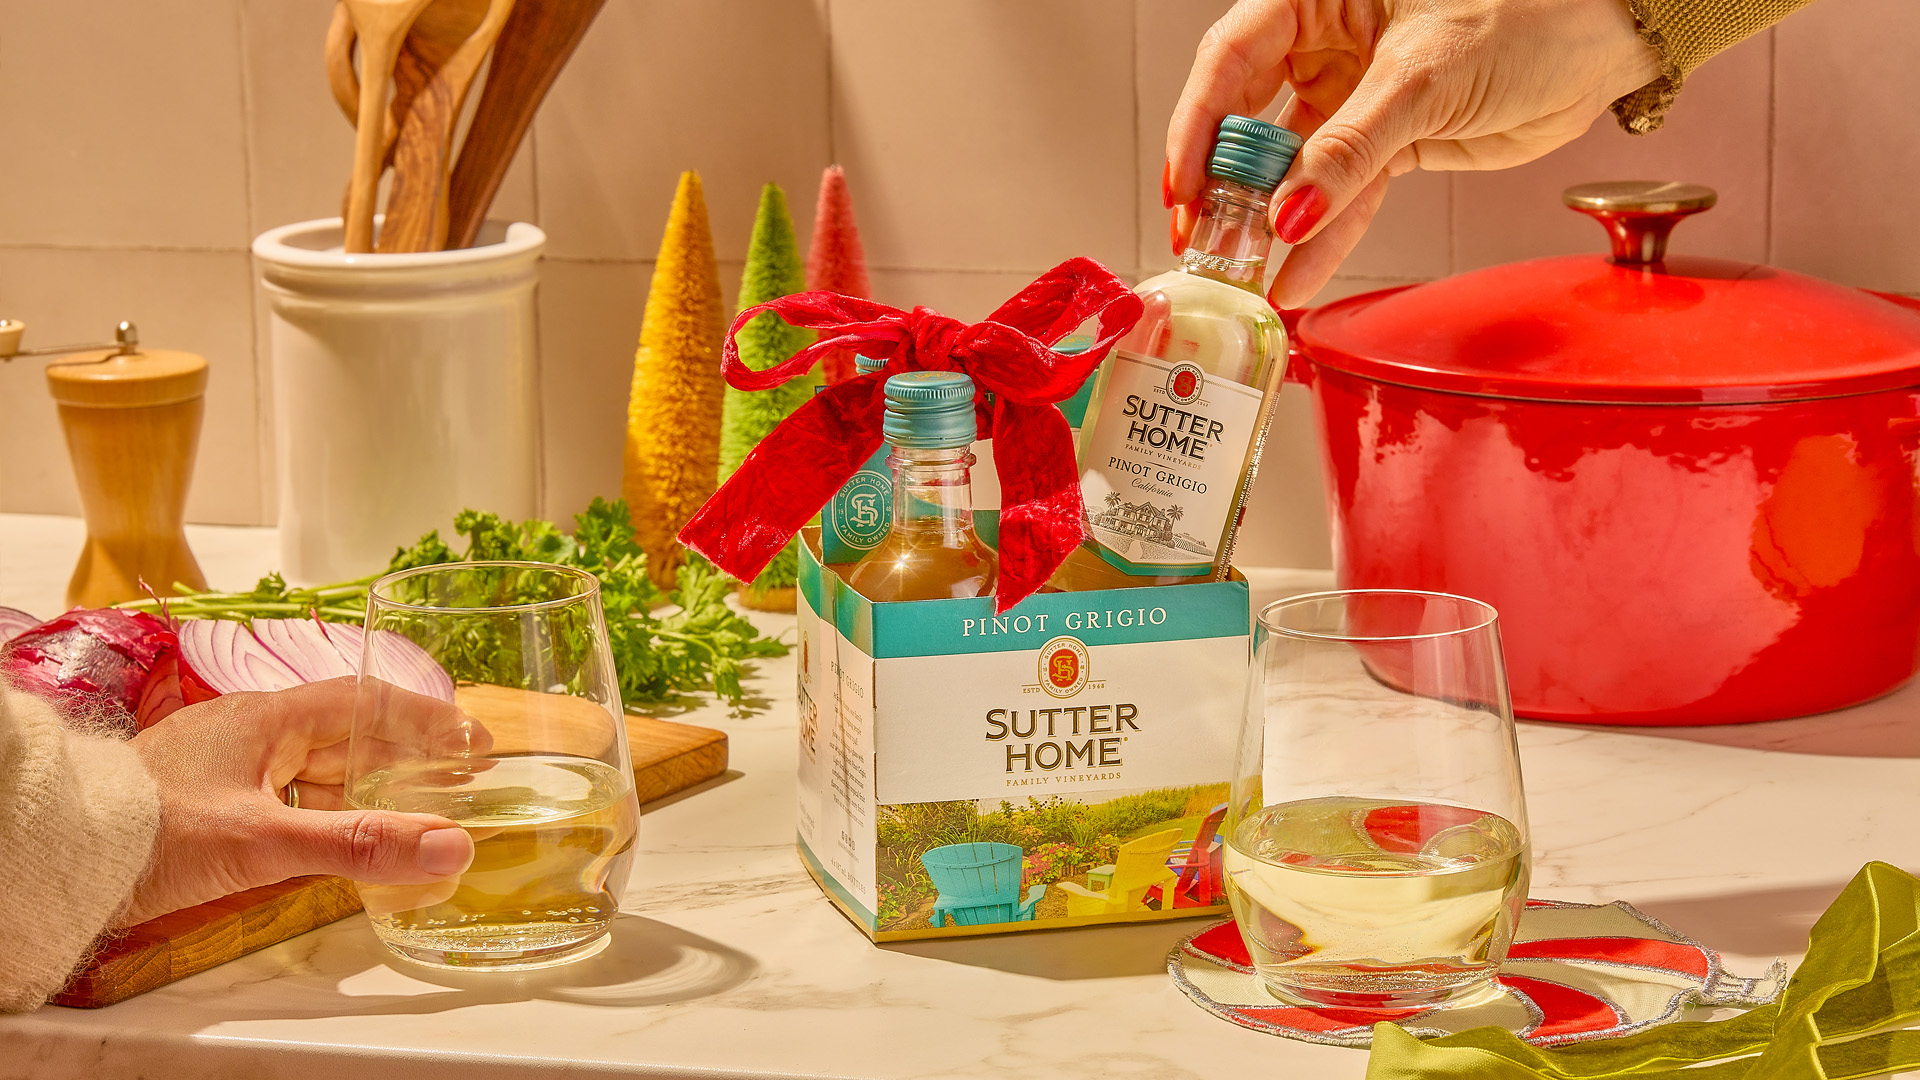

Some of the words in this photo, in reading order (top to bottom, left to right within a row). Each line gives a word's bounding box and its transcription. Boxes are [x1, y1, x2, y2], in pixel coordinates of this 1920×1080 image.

[1153, 387, 1166, 395] ESTD
[1122, 394, 1224, 444] SUTTER
[1127, 420, 1208, 462] HOME
[1125, 443, 1154, 457] FAMILY
[1157, 452, 1202, 470] VINEYARDS
[839, 476, 866, 498] SUTTER
[870, 477, 890, 496] HOME
[1108, 456, 1152, 478] PINOT
[1155, 470, 1208, 495] GRIGIO
[1131, 478, 1174, 498] California
[840, 524, 863, 543] FAMILY
[867, 522, 890, 543] OWNED
[962, 614, 1049, 637] PINOT
[1065, 607, 1168, 630] GRIGIO
[1044, 643, 1066, 659] SUTTER
[1068, 644, 1084, 658] HOME
[846, 675, 864, 699] GRIGIO
[1045, 679, 1062, 694] FAMILY
[1064, 677, 1083, 694] OWNED
[985, 703, 1142, 742] SUTTER
[1005, 737, 1123, 774] HOME
[1006, 776, 1049, 787] FAMILY
[1055, 772, 1122, 784] VINEYARDS
